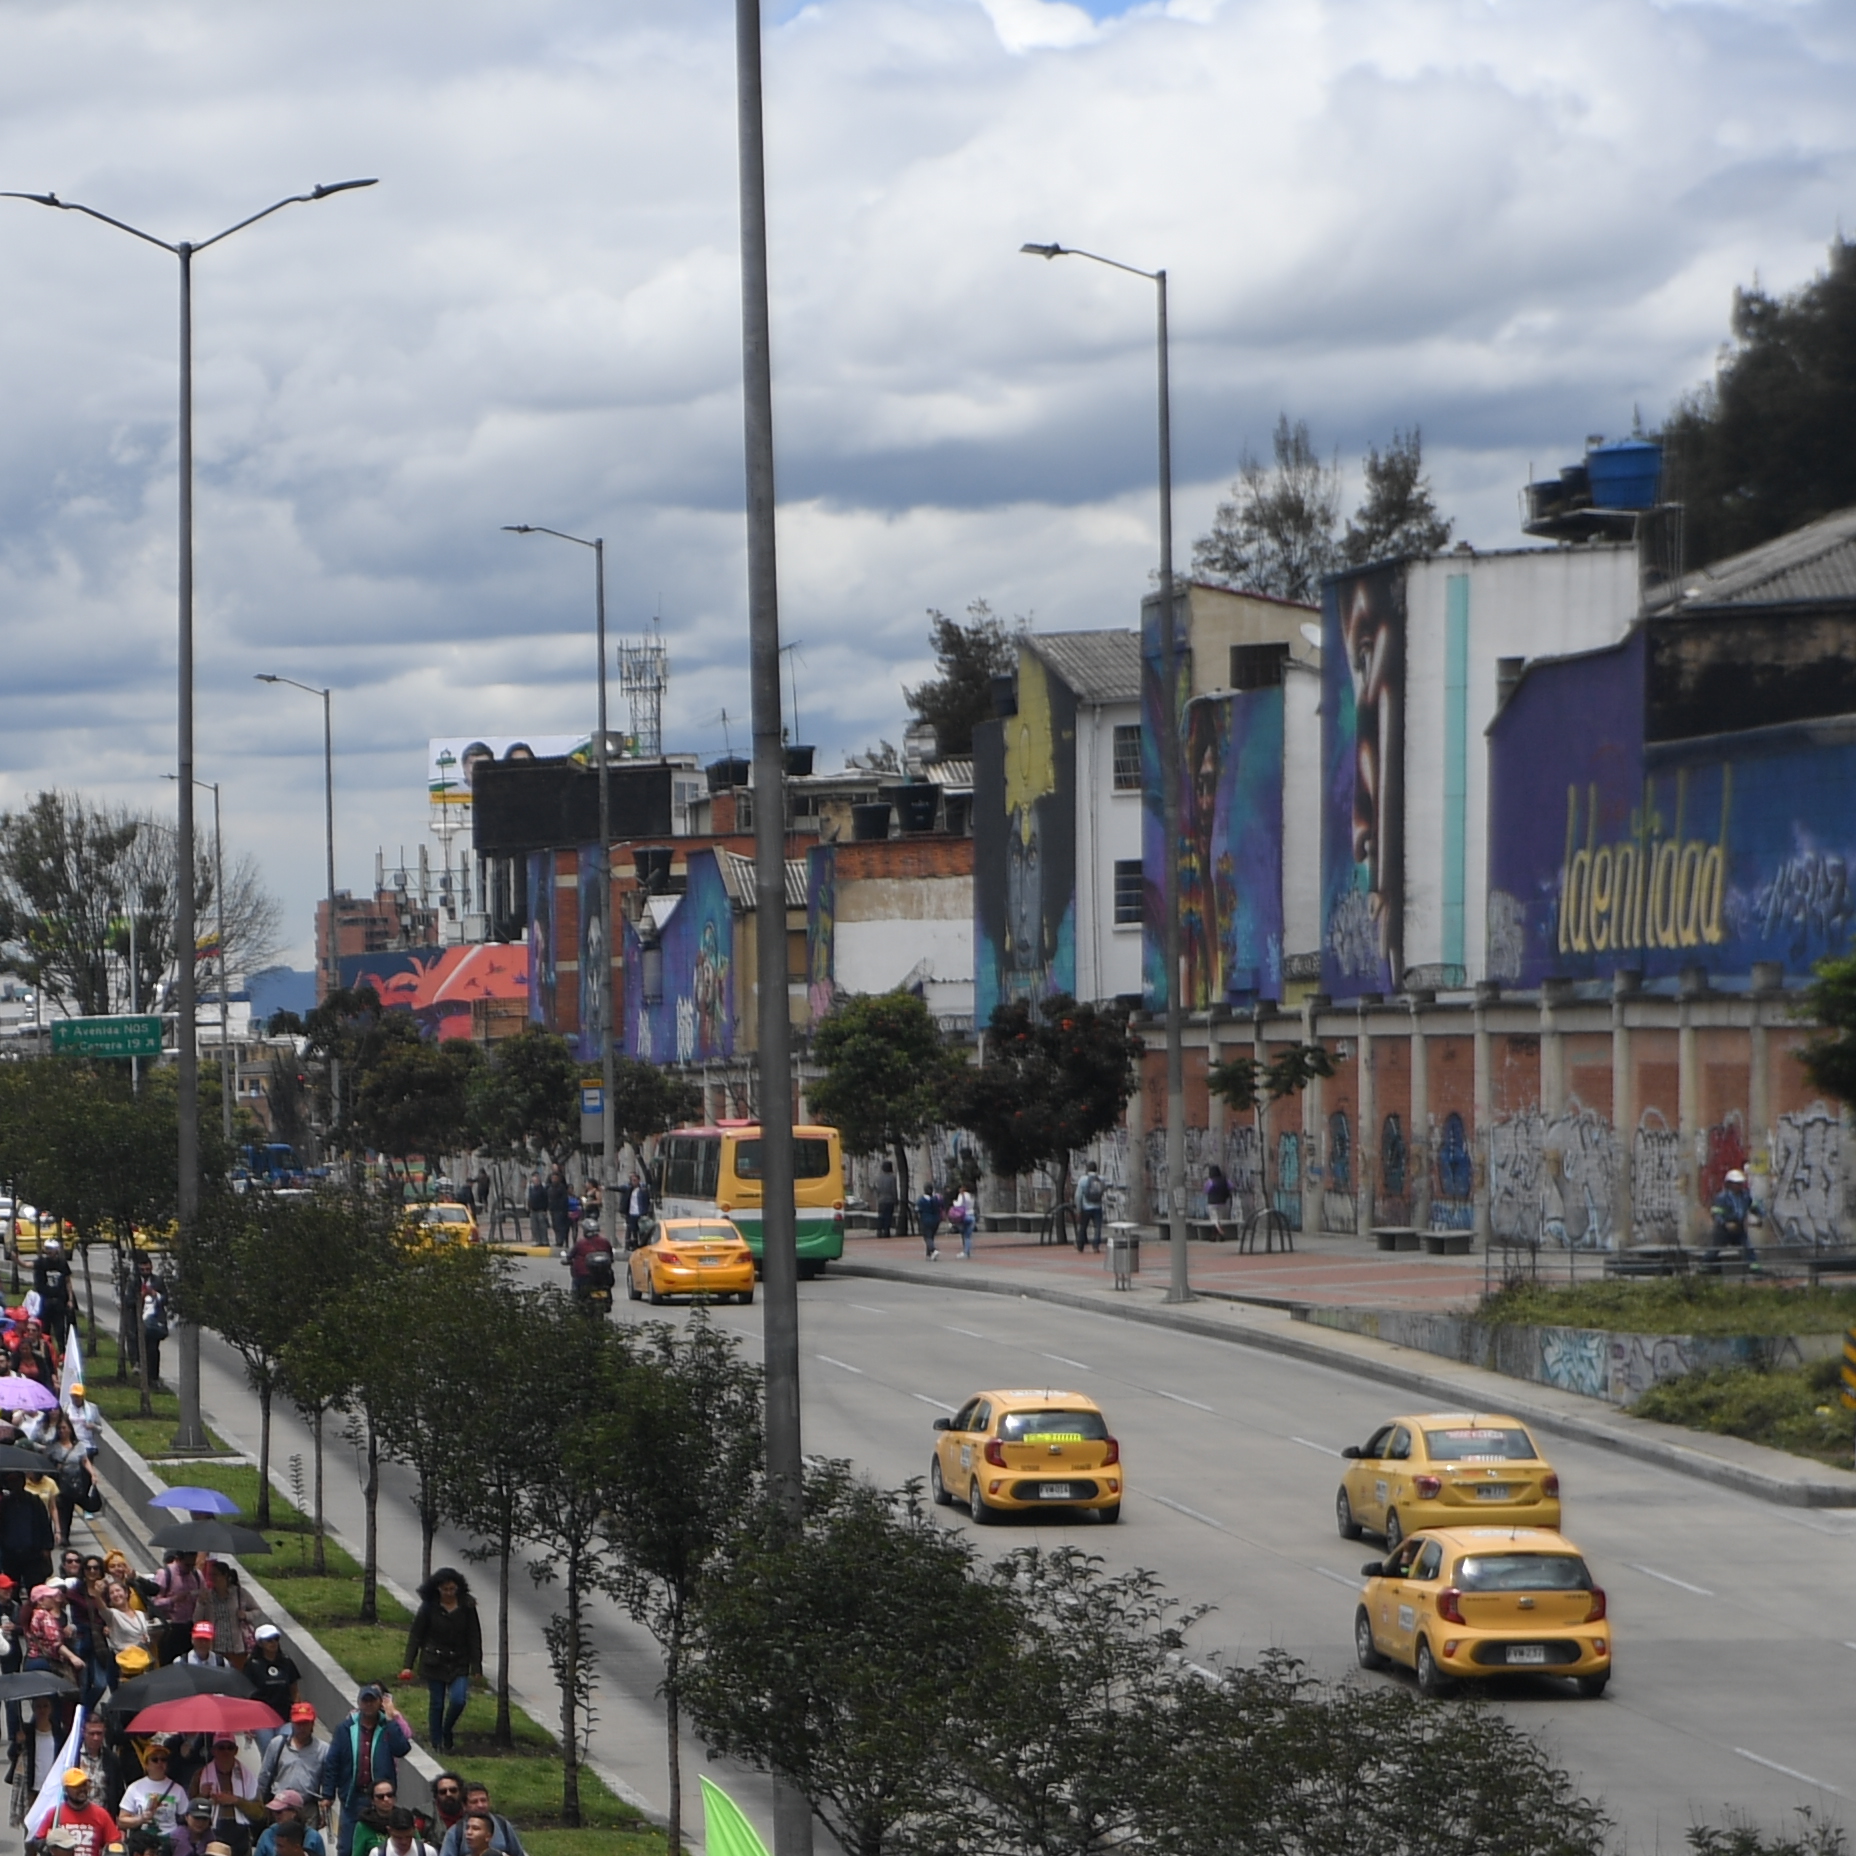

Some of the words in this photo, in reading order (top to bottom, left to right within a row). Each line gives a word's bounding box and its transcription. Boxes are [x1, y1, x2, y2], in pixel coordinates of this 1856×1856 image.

[1557, 763, 1731, 955] Identidad
[73, 1025, 119, 1036] Avenida
[124, 1022, 149, 1034] NQS
[127, 1039, 140, 1049] 19
